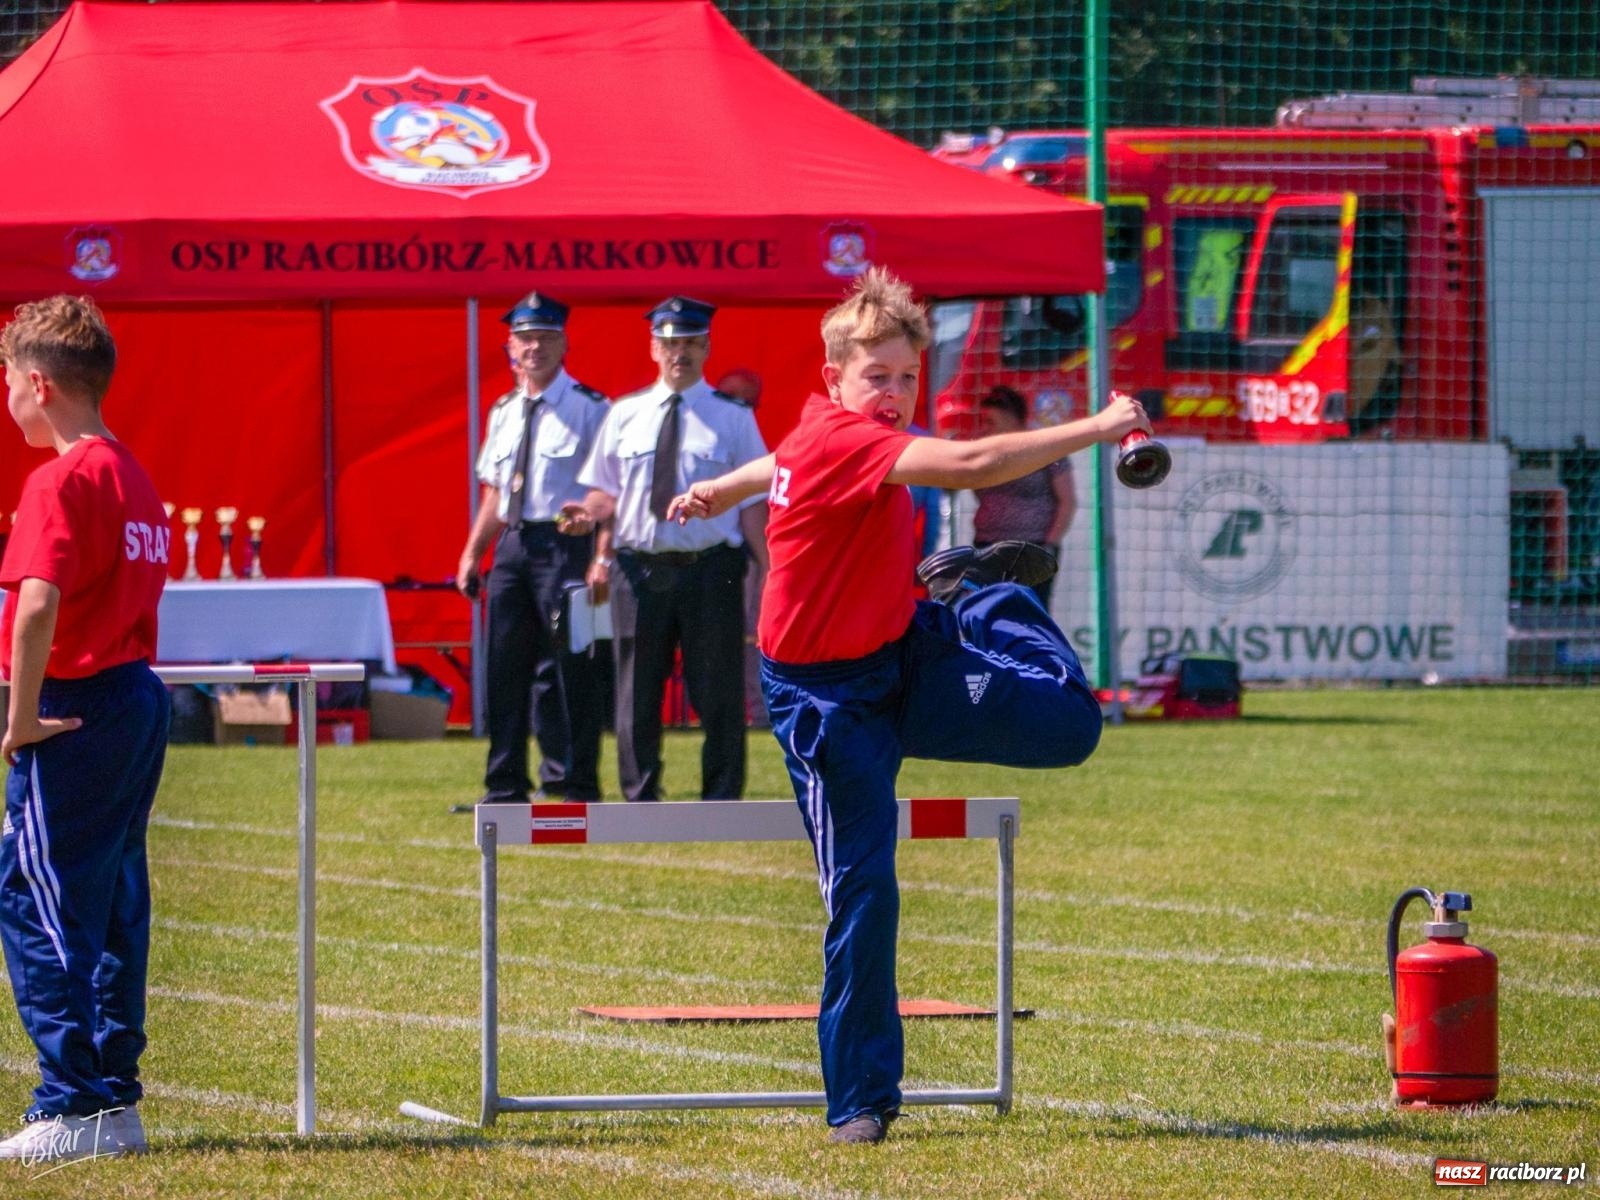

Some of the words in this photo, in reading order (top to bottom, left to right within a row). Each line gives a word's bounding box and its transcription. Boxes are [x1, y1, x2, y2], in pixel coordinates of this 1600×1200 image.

[170, 240, 251, 273] OSP
[262, 232, 782, 274] RACIBÓRZ-MARKOWICE
[1147, 615, 1454, 663] PAŃSTWOWE
